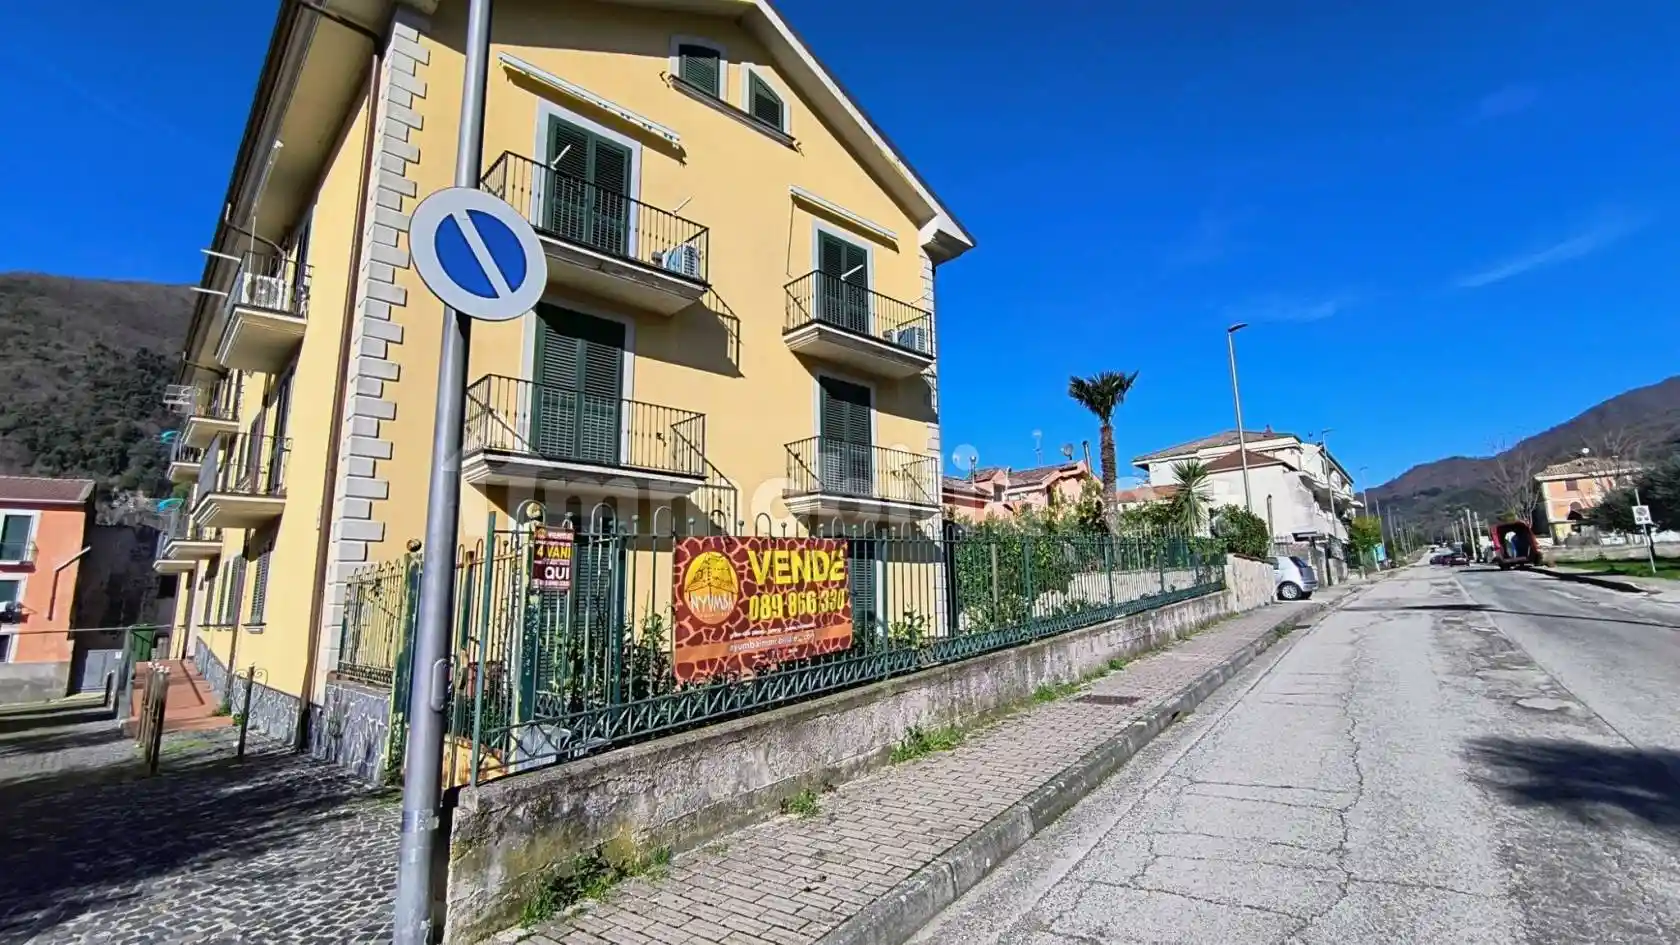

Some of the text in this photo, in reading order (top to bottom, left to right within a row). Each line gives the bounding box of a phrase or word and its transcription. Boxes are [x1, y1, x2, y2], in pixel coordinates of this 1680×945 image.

[547, 545, 571, 560] VANI
[544, 566, 570, 581] QUI
[748, 549, 845, 585] VENDE
[748, 593, 784, 621] 089
